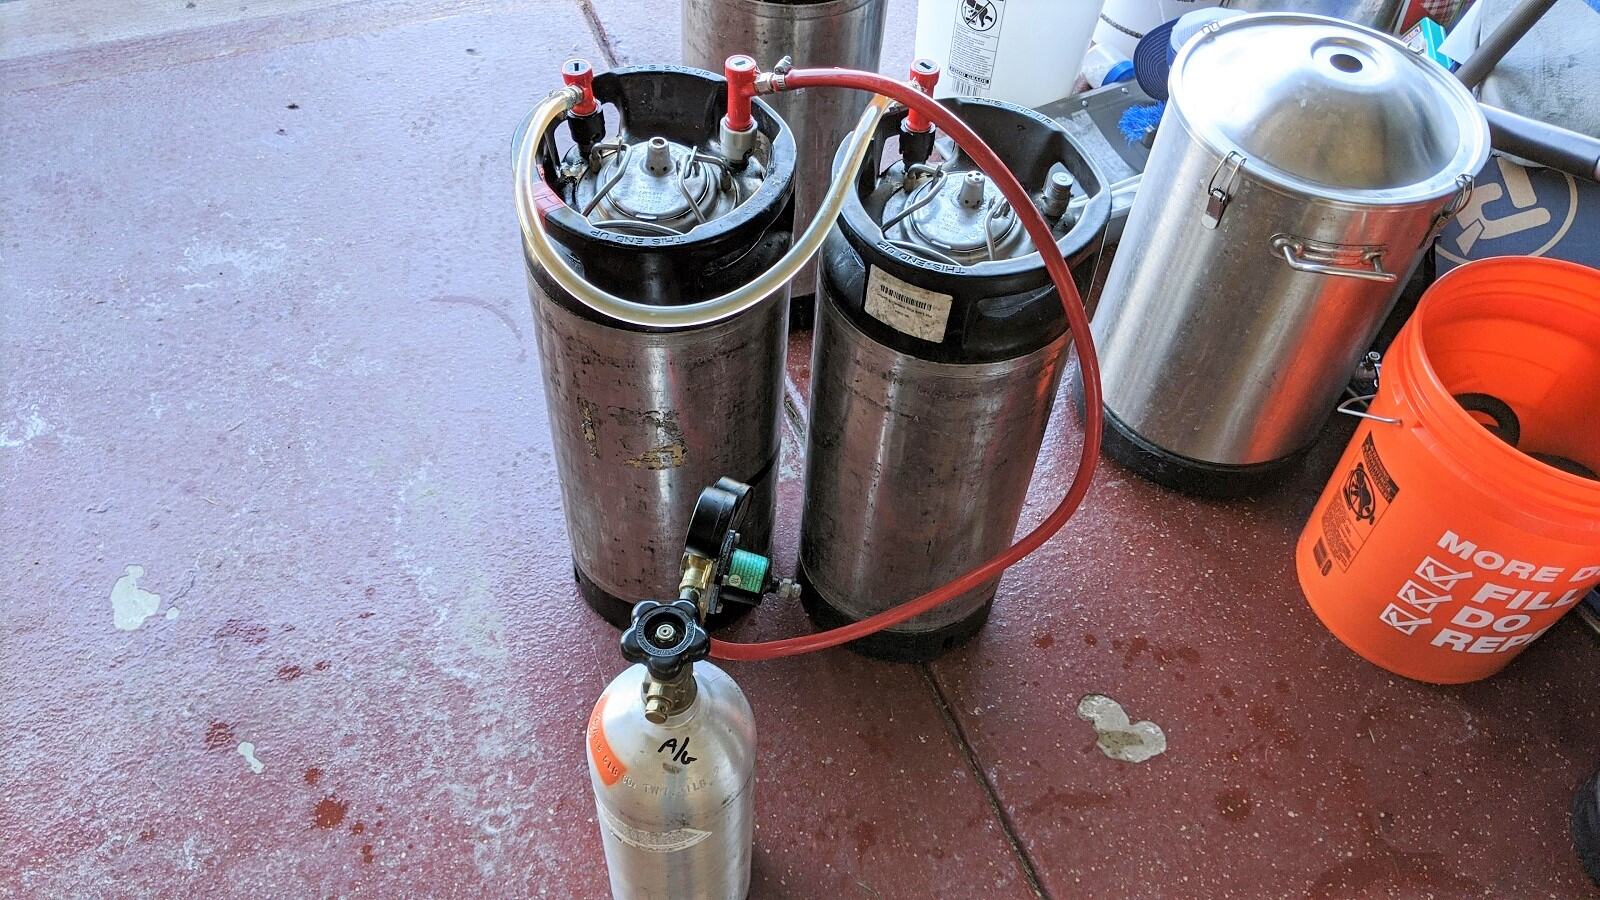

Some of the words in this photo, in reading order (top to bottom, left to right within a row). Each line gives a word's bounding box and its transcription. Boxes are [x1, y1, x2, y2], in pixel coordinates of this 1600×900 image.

[1437, 529, 1565, 583] MORE
[1471, 582, 1578, 611] FILL
[1450, 605, 1531, 633] DO
